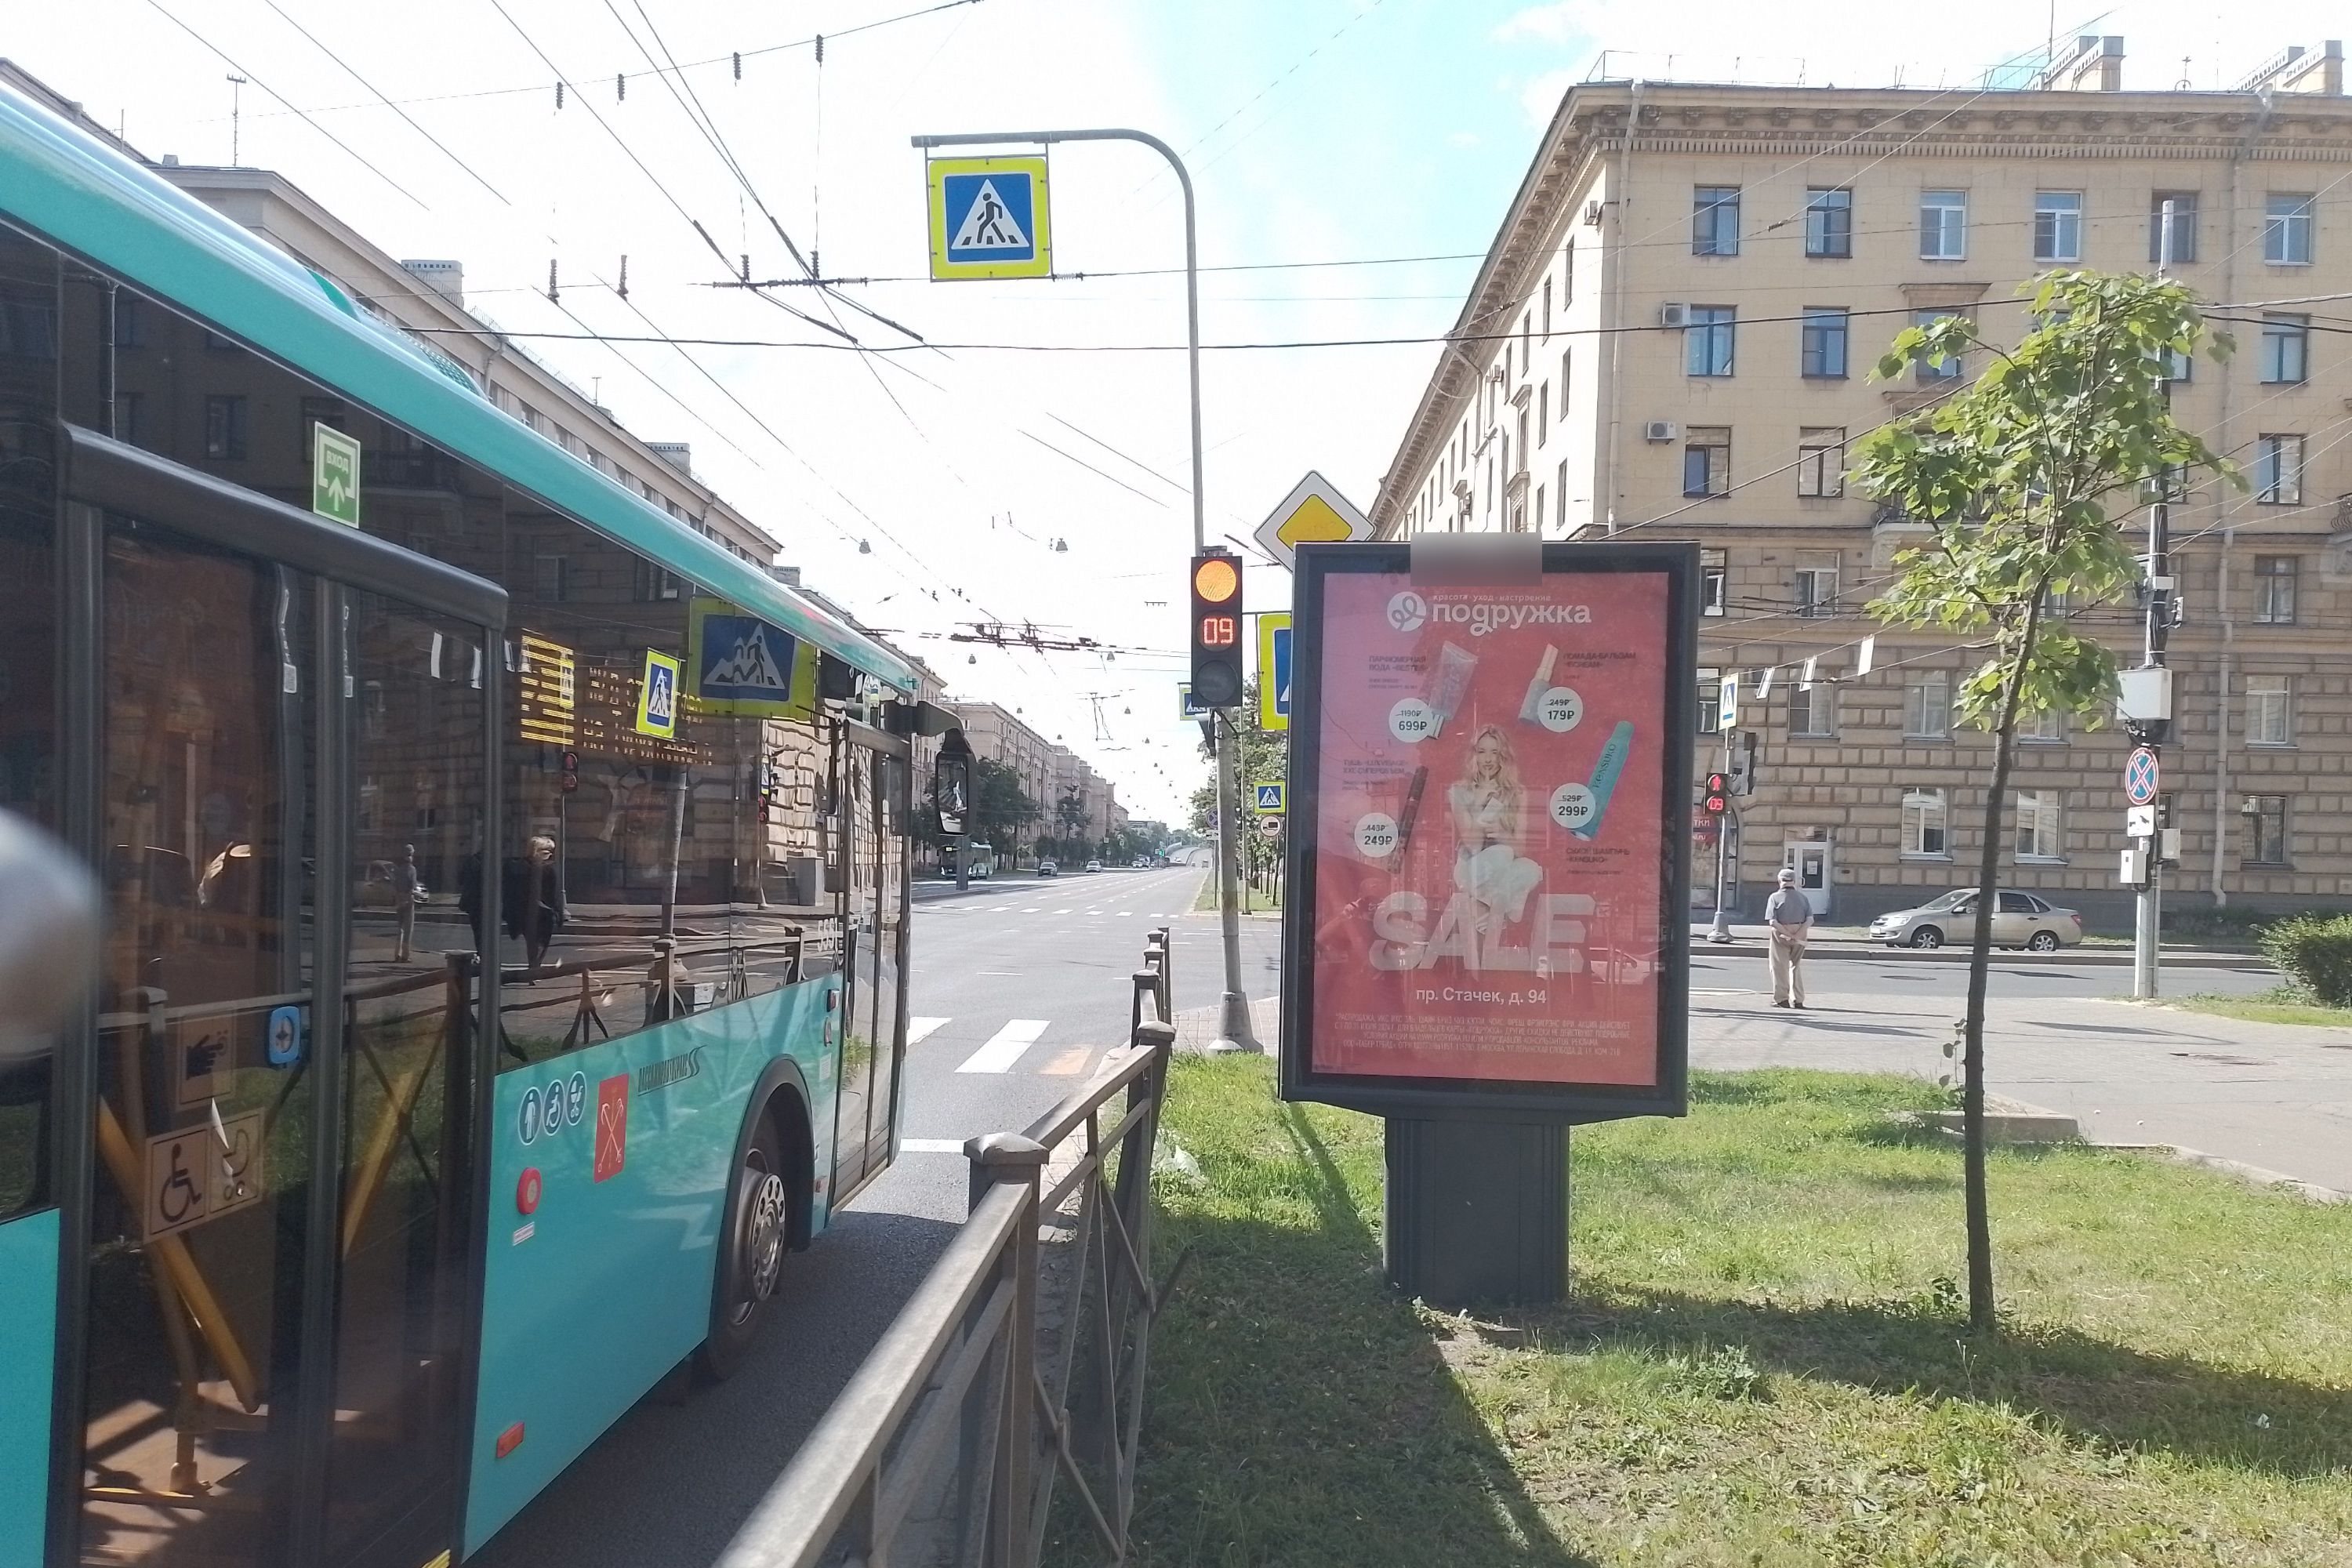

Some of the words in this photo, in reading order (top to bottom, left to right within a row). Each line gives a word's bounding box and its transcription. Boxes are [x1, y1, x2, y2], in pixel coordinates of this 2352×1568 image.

[326, 450, 350, 474] ВХОД
[1433, 593, 1468, 603] красота
[1472, 594, 1494, 603] уход
[1499, 594, 1552, 603] настроение
[1203, 618, 1233, 644] 09
[1432, 603, 1592, 637] подружка
[1368, 891, 1596, 974] SALE
[1415, 988, 1439, 1004] пр.
[1443, 986, 1506, 1006] Стачек,
[1508, 990, 1525, 1006] д.
[1528, 988, 1548, 1004] 94
